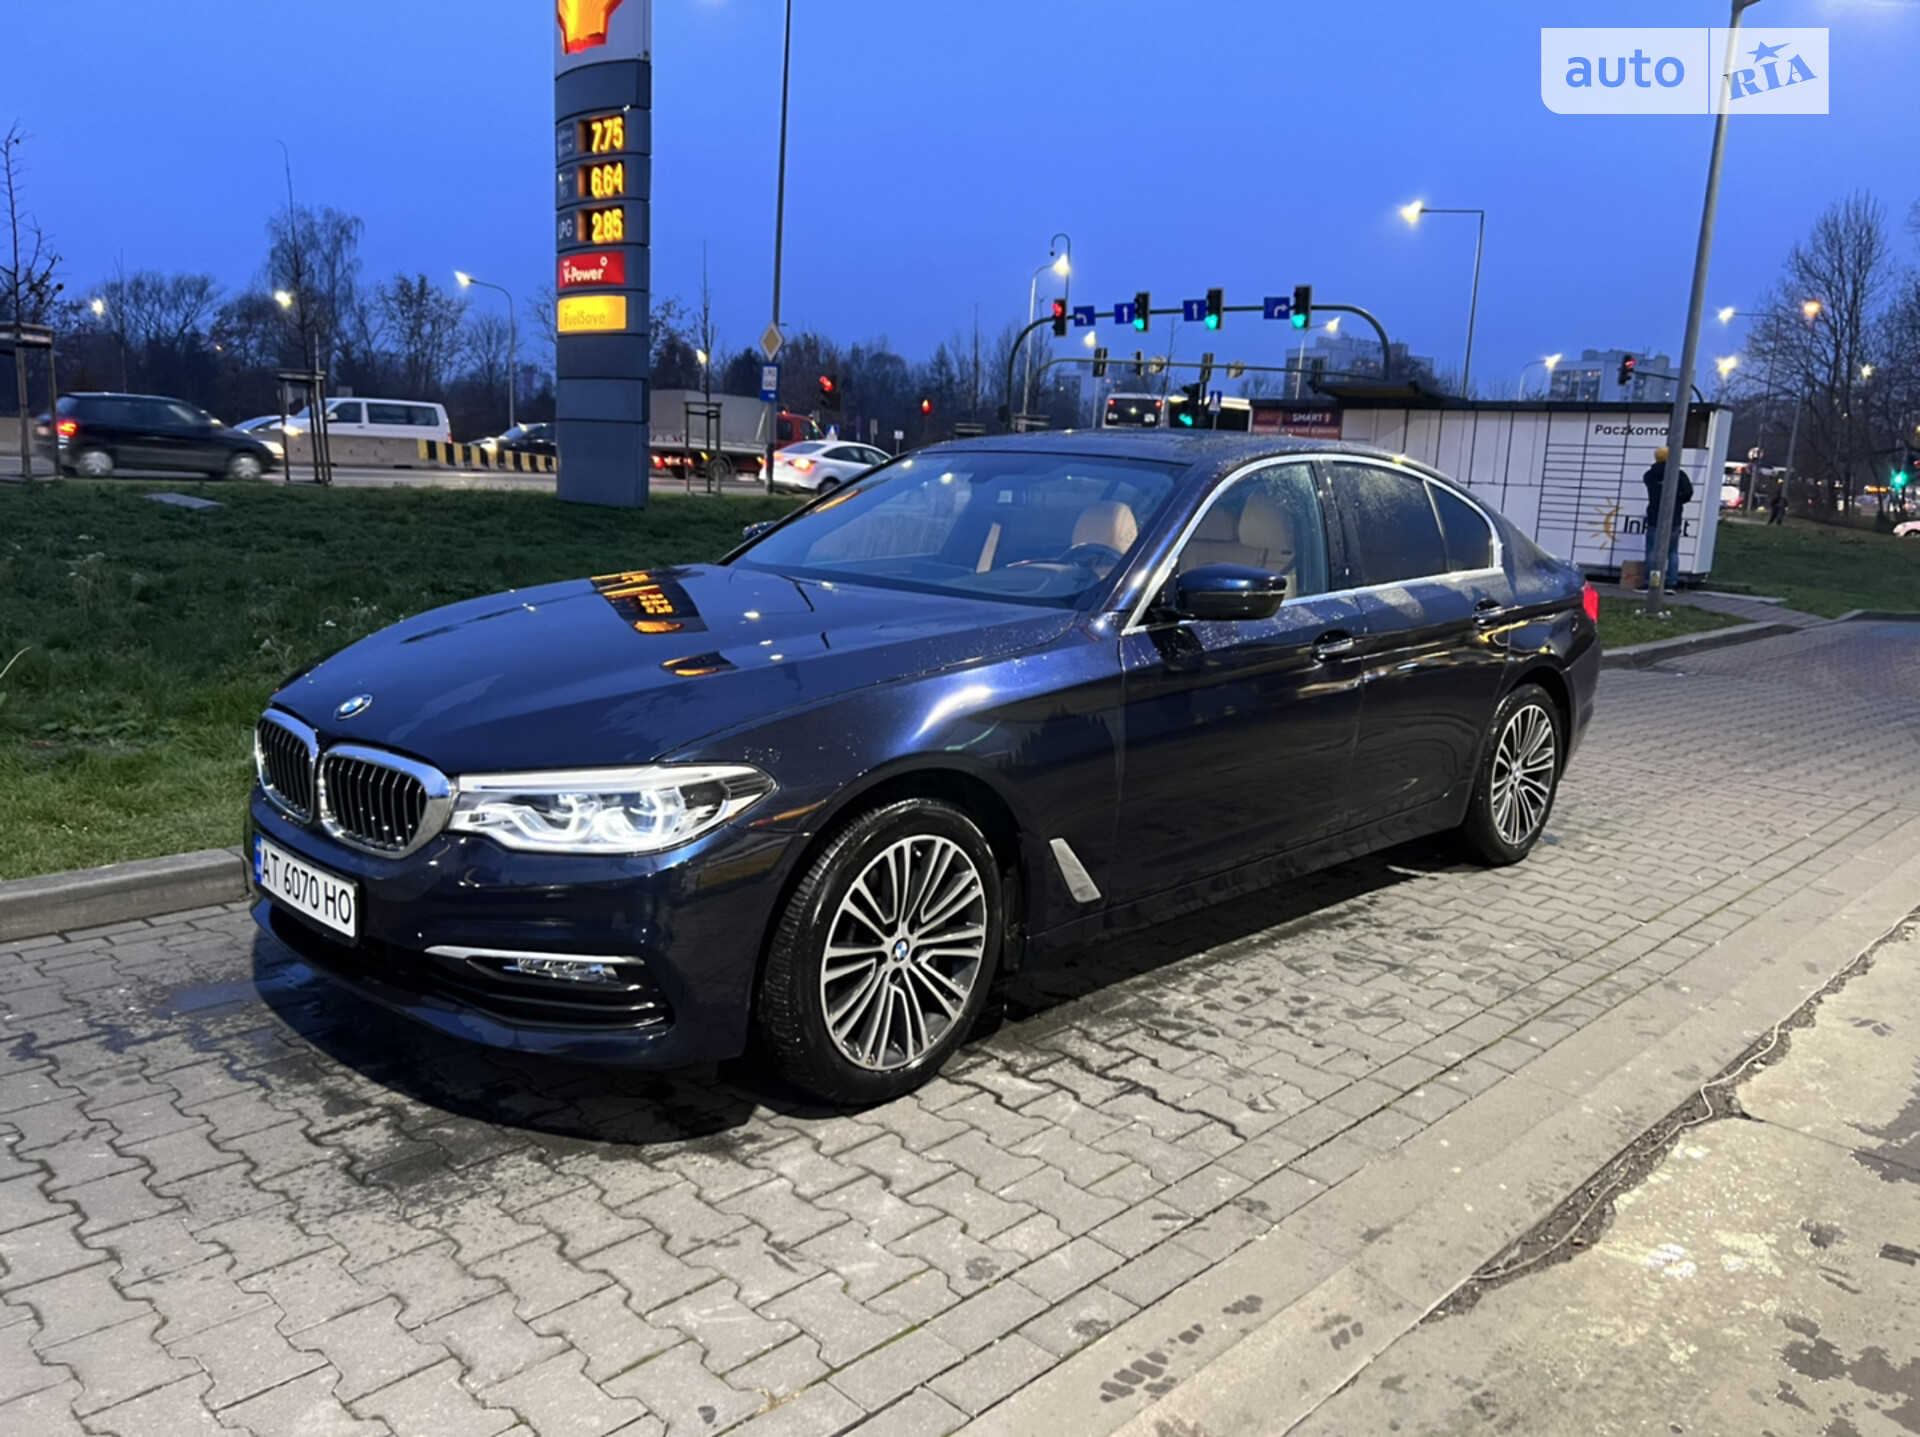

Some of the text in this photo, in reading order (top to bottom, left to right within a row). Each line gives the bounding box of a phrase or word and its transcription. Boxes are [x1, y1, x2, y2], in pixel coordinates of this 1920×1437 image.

[592, 116, 624, 153] 7.75
[1595, 424, 1669, 437] Paczkoma
[263, 849, 352, 925] AT 6070 HO
